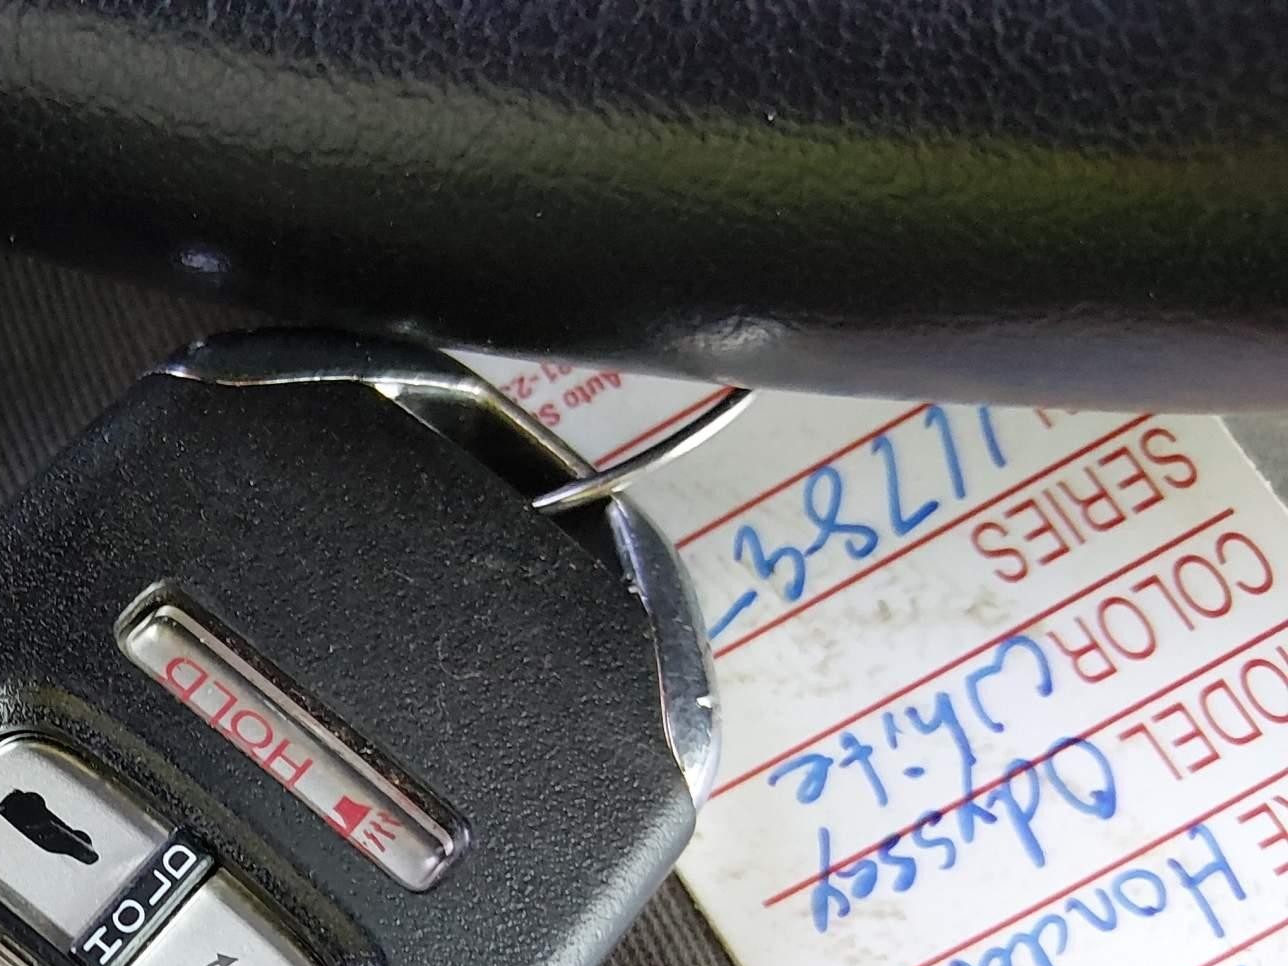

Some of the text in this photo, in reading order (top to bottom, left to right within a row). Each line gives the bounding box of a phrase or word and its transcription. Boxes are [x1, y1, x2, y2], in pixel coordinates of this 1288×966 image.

[531, 370, 621, 426] Auto S
[971, 427, 1198, 583] SERIES
[1046, 531, 1274, 684] COLOR
[160, 656, 314, 789] HOLD
[768, 635, 1053, 807] White
[1118, 644, 1288, 781] ODEL
[811, 737, 1117, 932] Odyssey
[1237, 795, 1288, 876] E
[82, 843, 198, 965] HOLD
